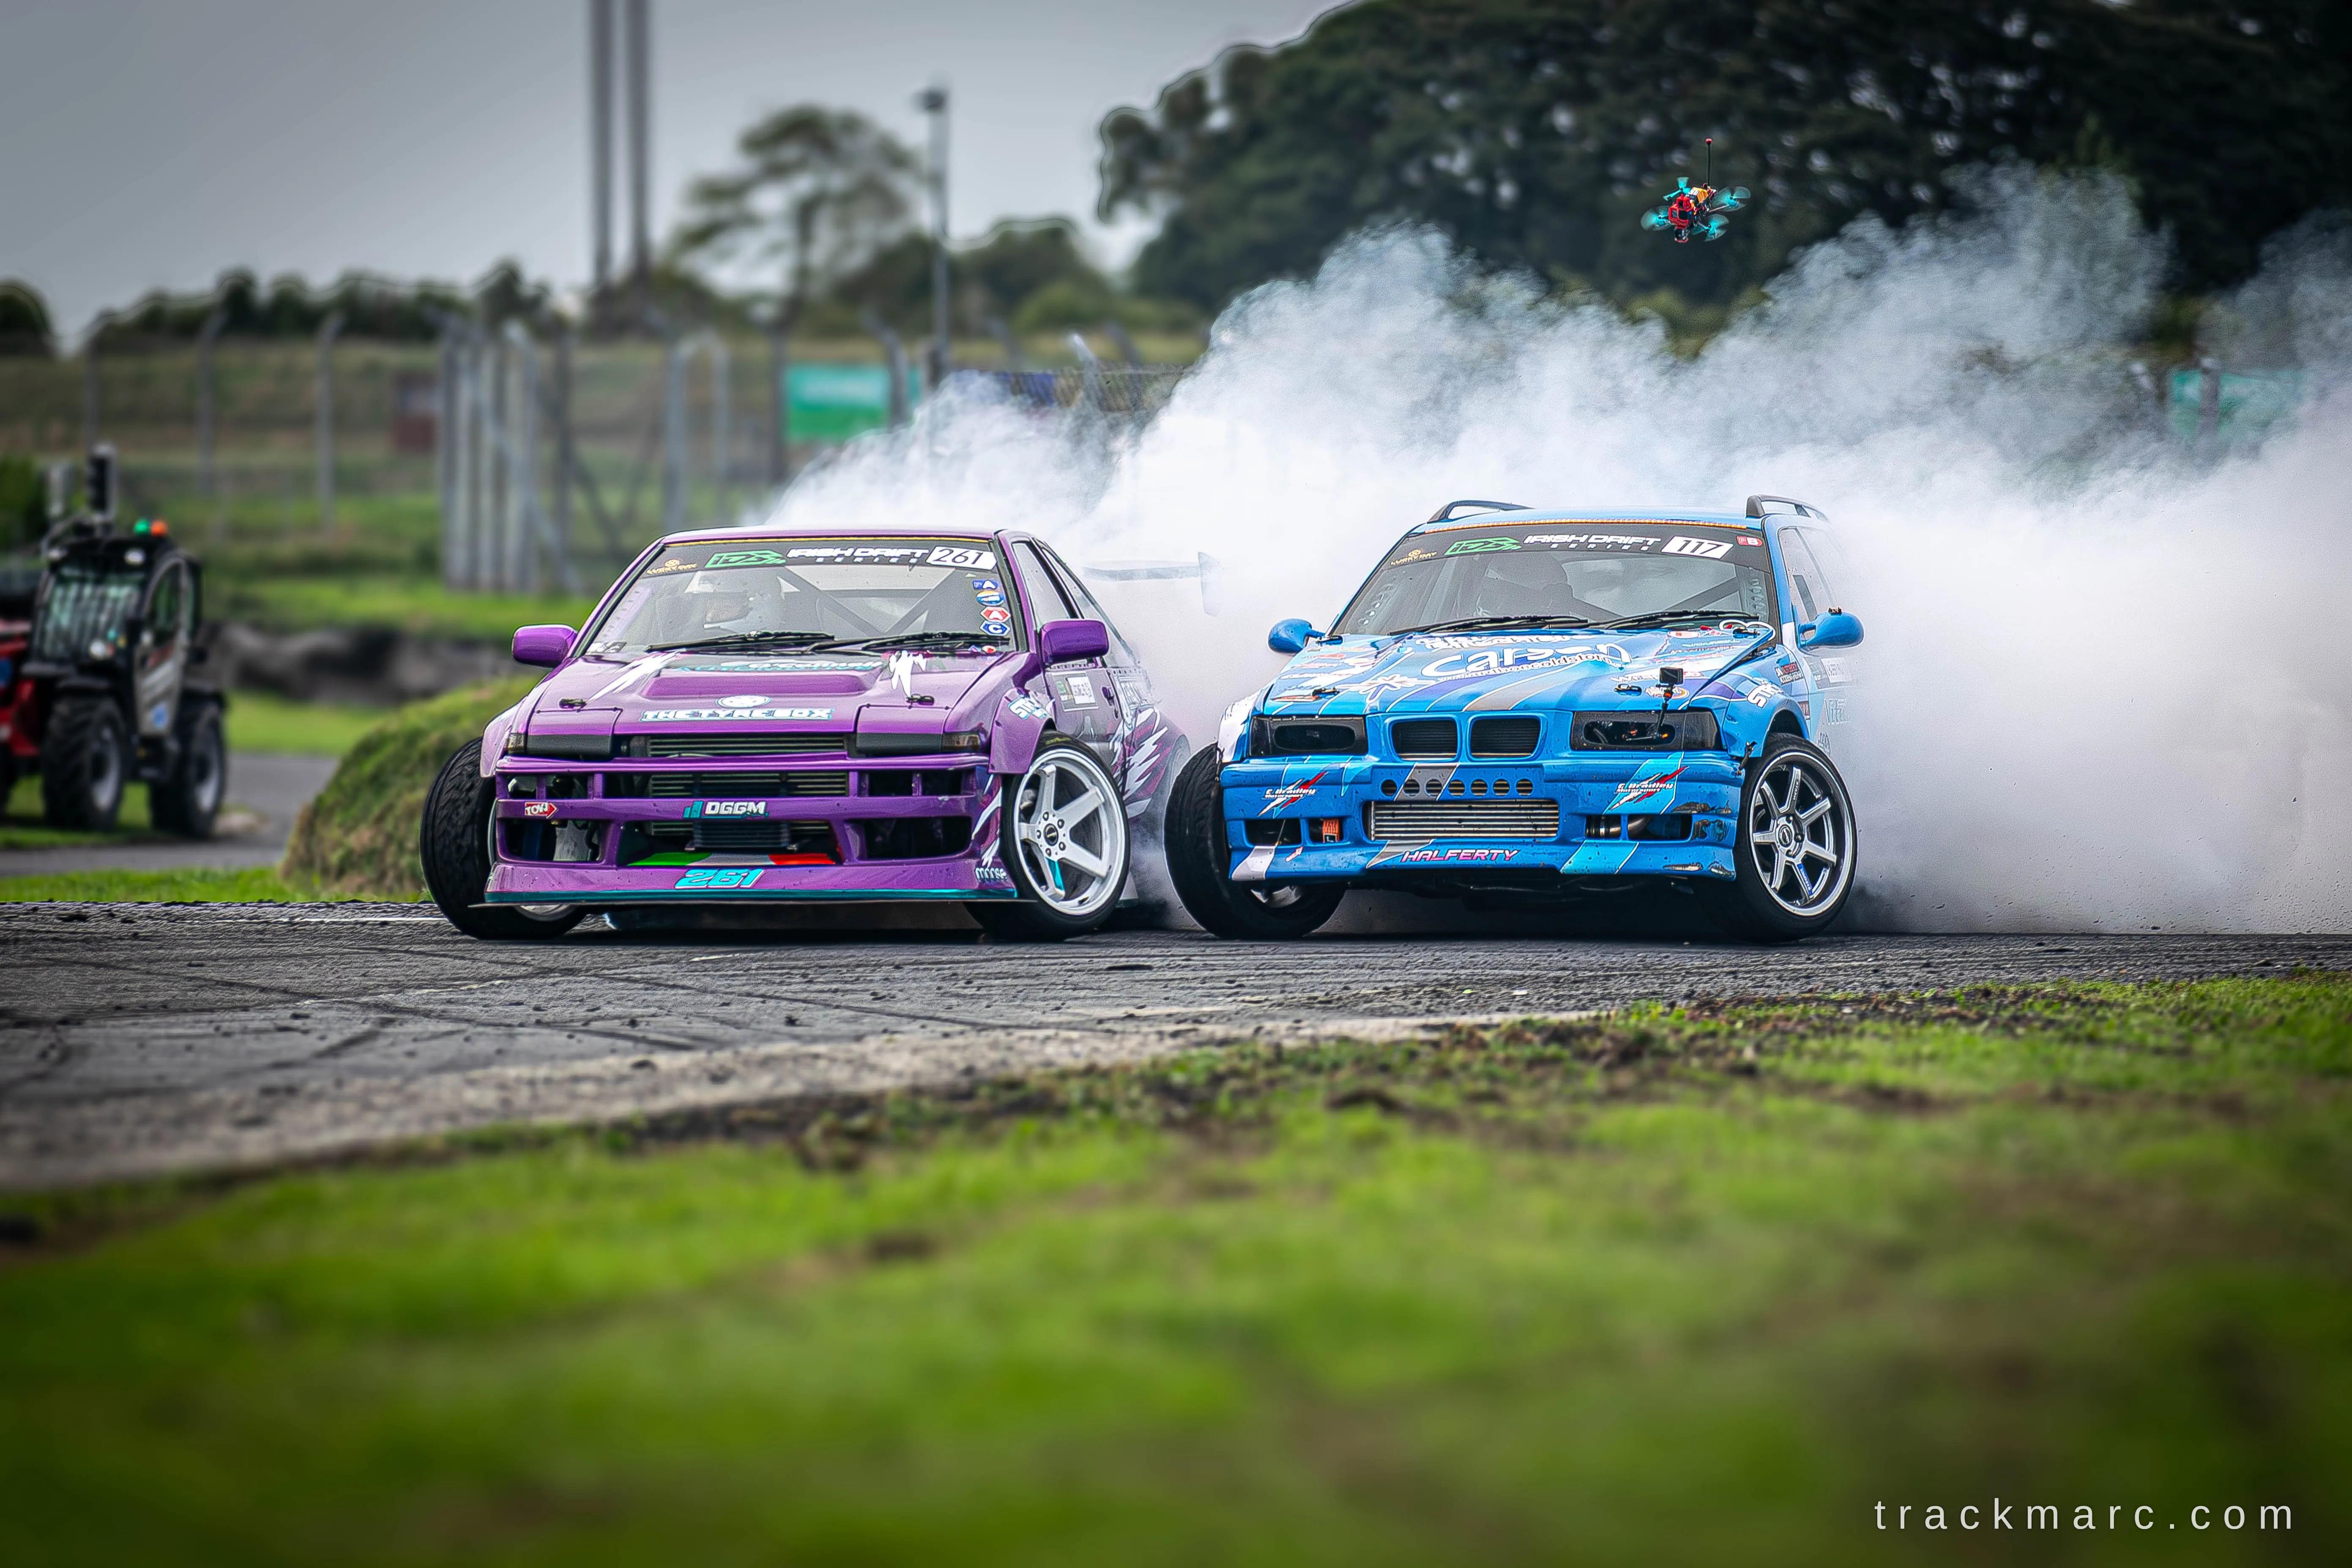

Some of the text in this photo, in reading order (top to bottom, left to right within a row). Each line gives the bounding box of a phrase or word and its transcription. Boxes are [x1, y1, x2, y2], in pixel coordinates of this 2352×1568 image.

[1523, 534, 1661, 546] IRISH DRIFT
[1677, 539, 1725, 555] 117
[853, 547, 930, 558] DRIFT
[933, 548, 984, 565] 261
[988, 624, 1003, 634] C
[1422, 642, 1633, 677] Carson
[525, 802, 549, 816] TOW
[1401, 849, 1519, 862] HALFERTY
[675, 868, 764, 889] 261
